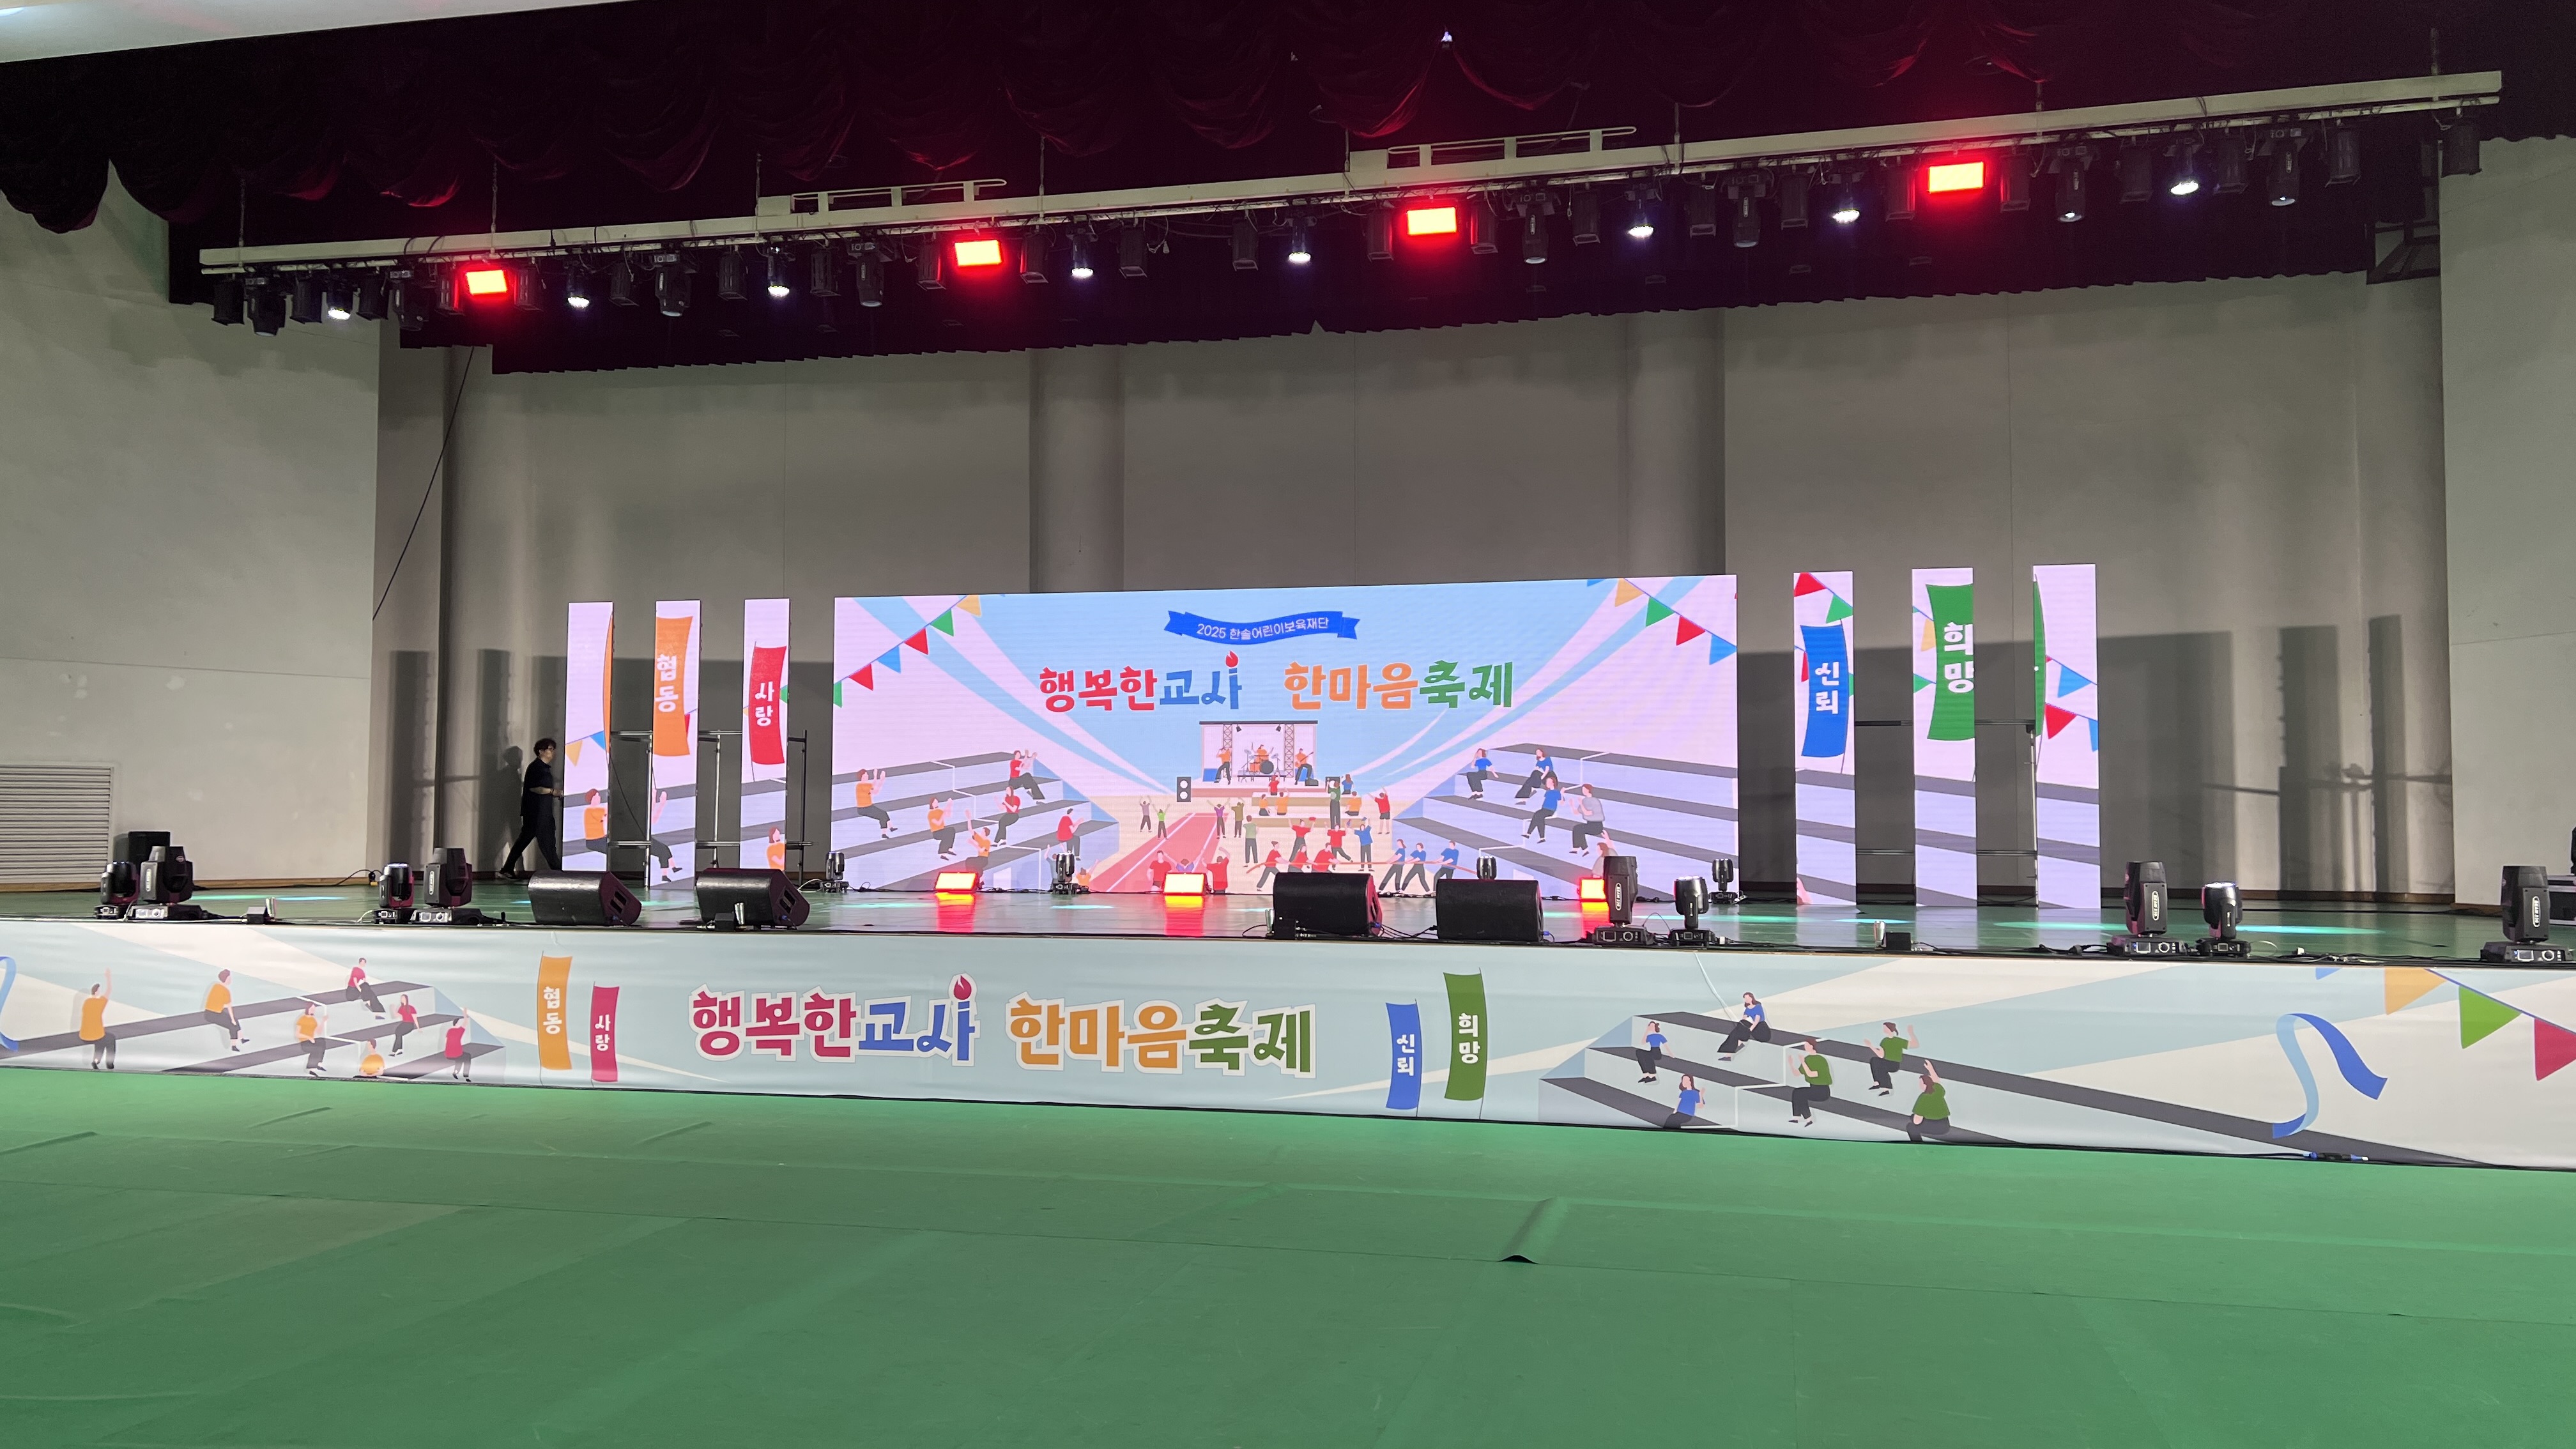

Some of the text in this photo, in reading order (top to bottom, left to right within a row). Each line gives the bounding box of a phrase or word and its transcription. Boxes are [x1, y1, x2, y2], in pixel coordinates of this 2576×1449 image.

[1196, 617, 1329, 640] 2025 한솔어린이보육재단
[1943, 621, 1974, 693] 희망
[655, 654, 678, 712] 협동
[755, 681, 774, 726] 사랑
[1814, 661, 1839, 714] 신뢰
[543, 986, 562, 1034] 협동
[594, 1014, 611, 1052] 사랑
[1397, 1033, 1415, 1077] 신뢰
[1458, 1012, 1481, 1064] 희망
